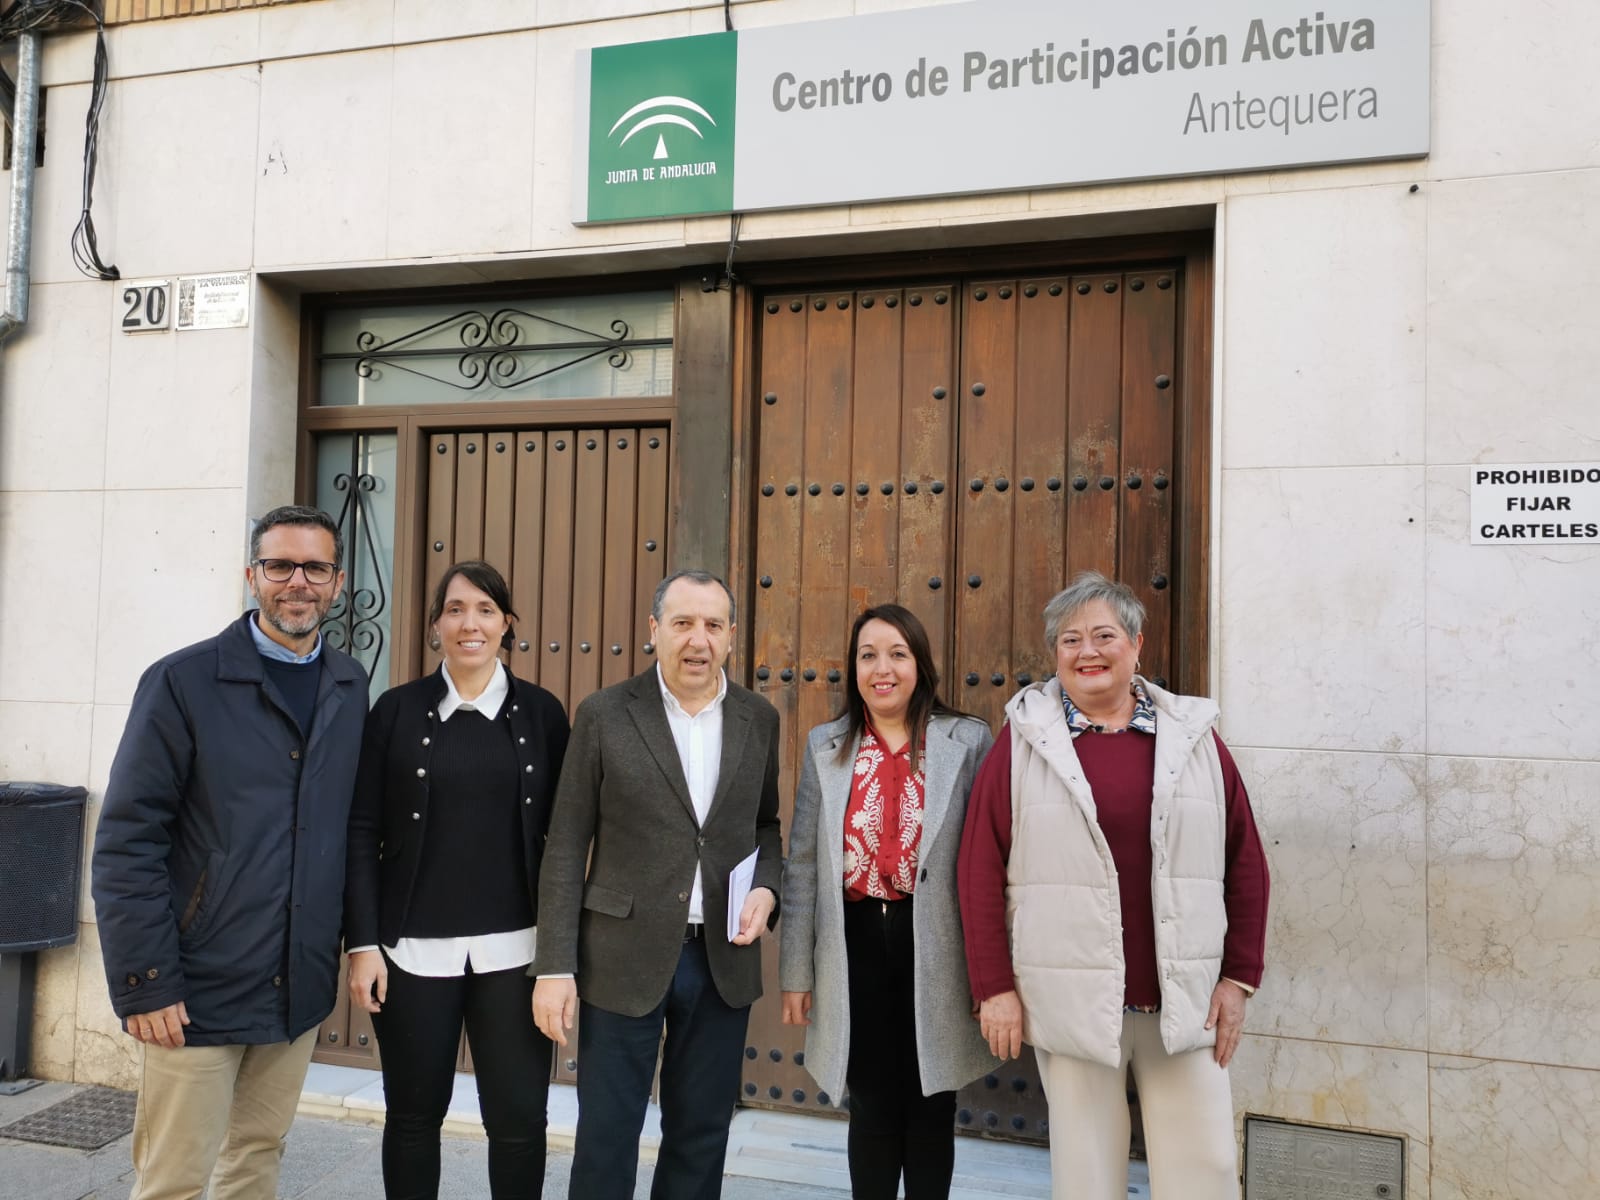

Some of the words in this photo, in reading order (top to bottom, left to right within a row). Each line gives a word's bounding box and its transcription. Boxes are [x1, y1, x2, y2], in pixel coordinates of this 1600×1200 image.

[772, 70, 892, 112] Centro
[905, 57, 949, 98] de
[963, 25, 1228, 92] Participación
[1241, 12, 1375, 63] Activa
[1183, 86, 1378, 135] Antequera
[605, 169, 638, 184] JUNTA
[642, 167, 655, 180] DE
[122, 286, 166, 327] 20
[1476, 469, 1600, 485] PROHIBIDO
[1506, 496, 1571, 511] FIJAR
[1480, 523, 1598, 538] CARTELES
